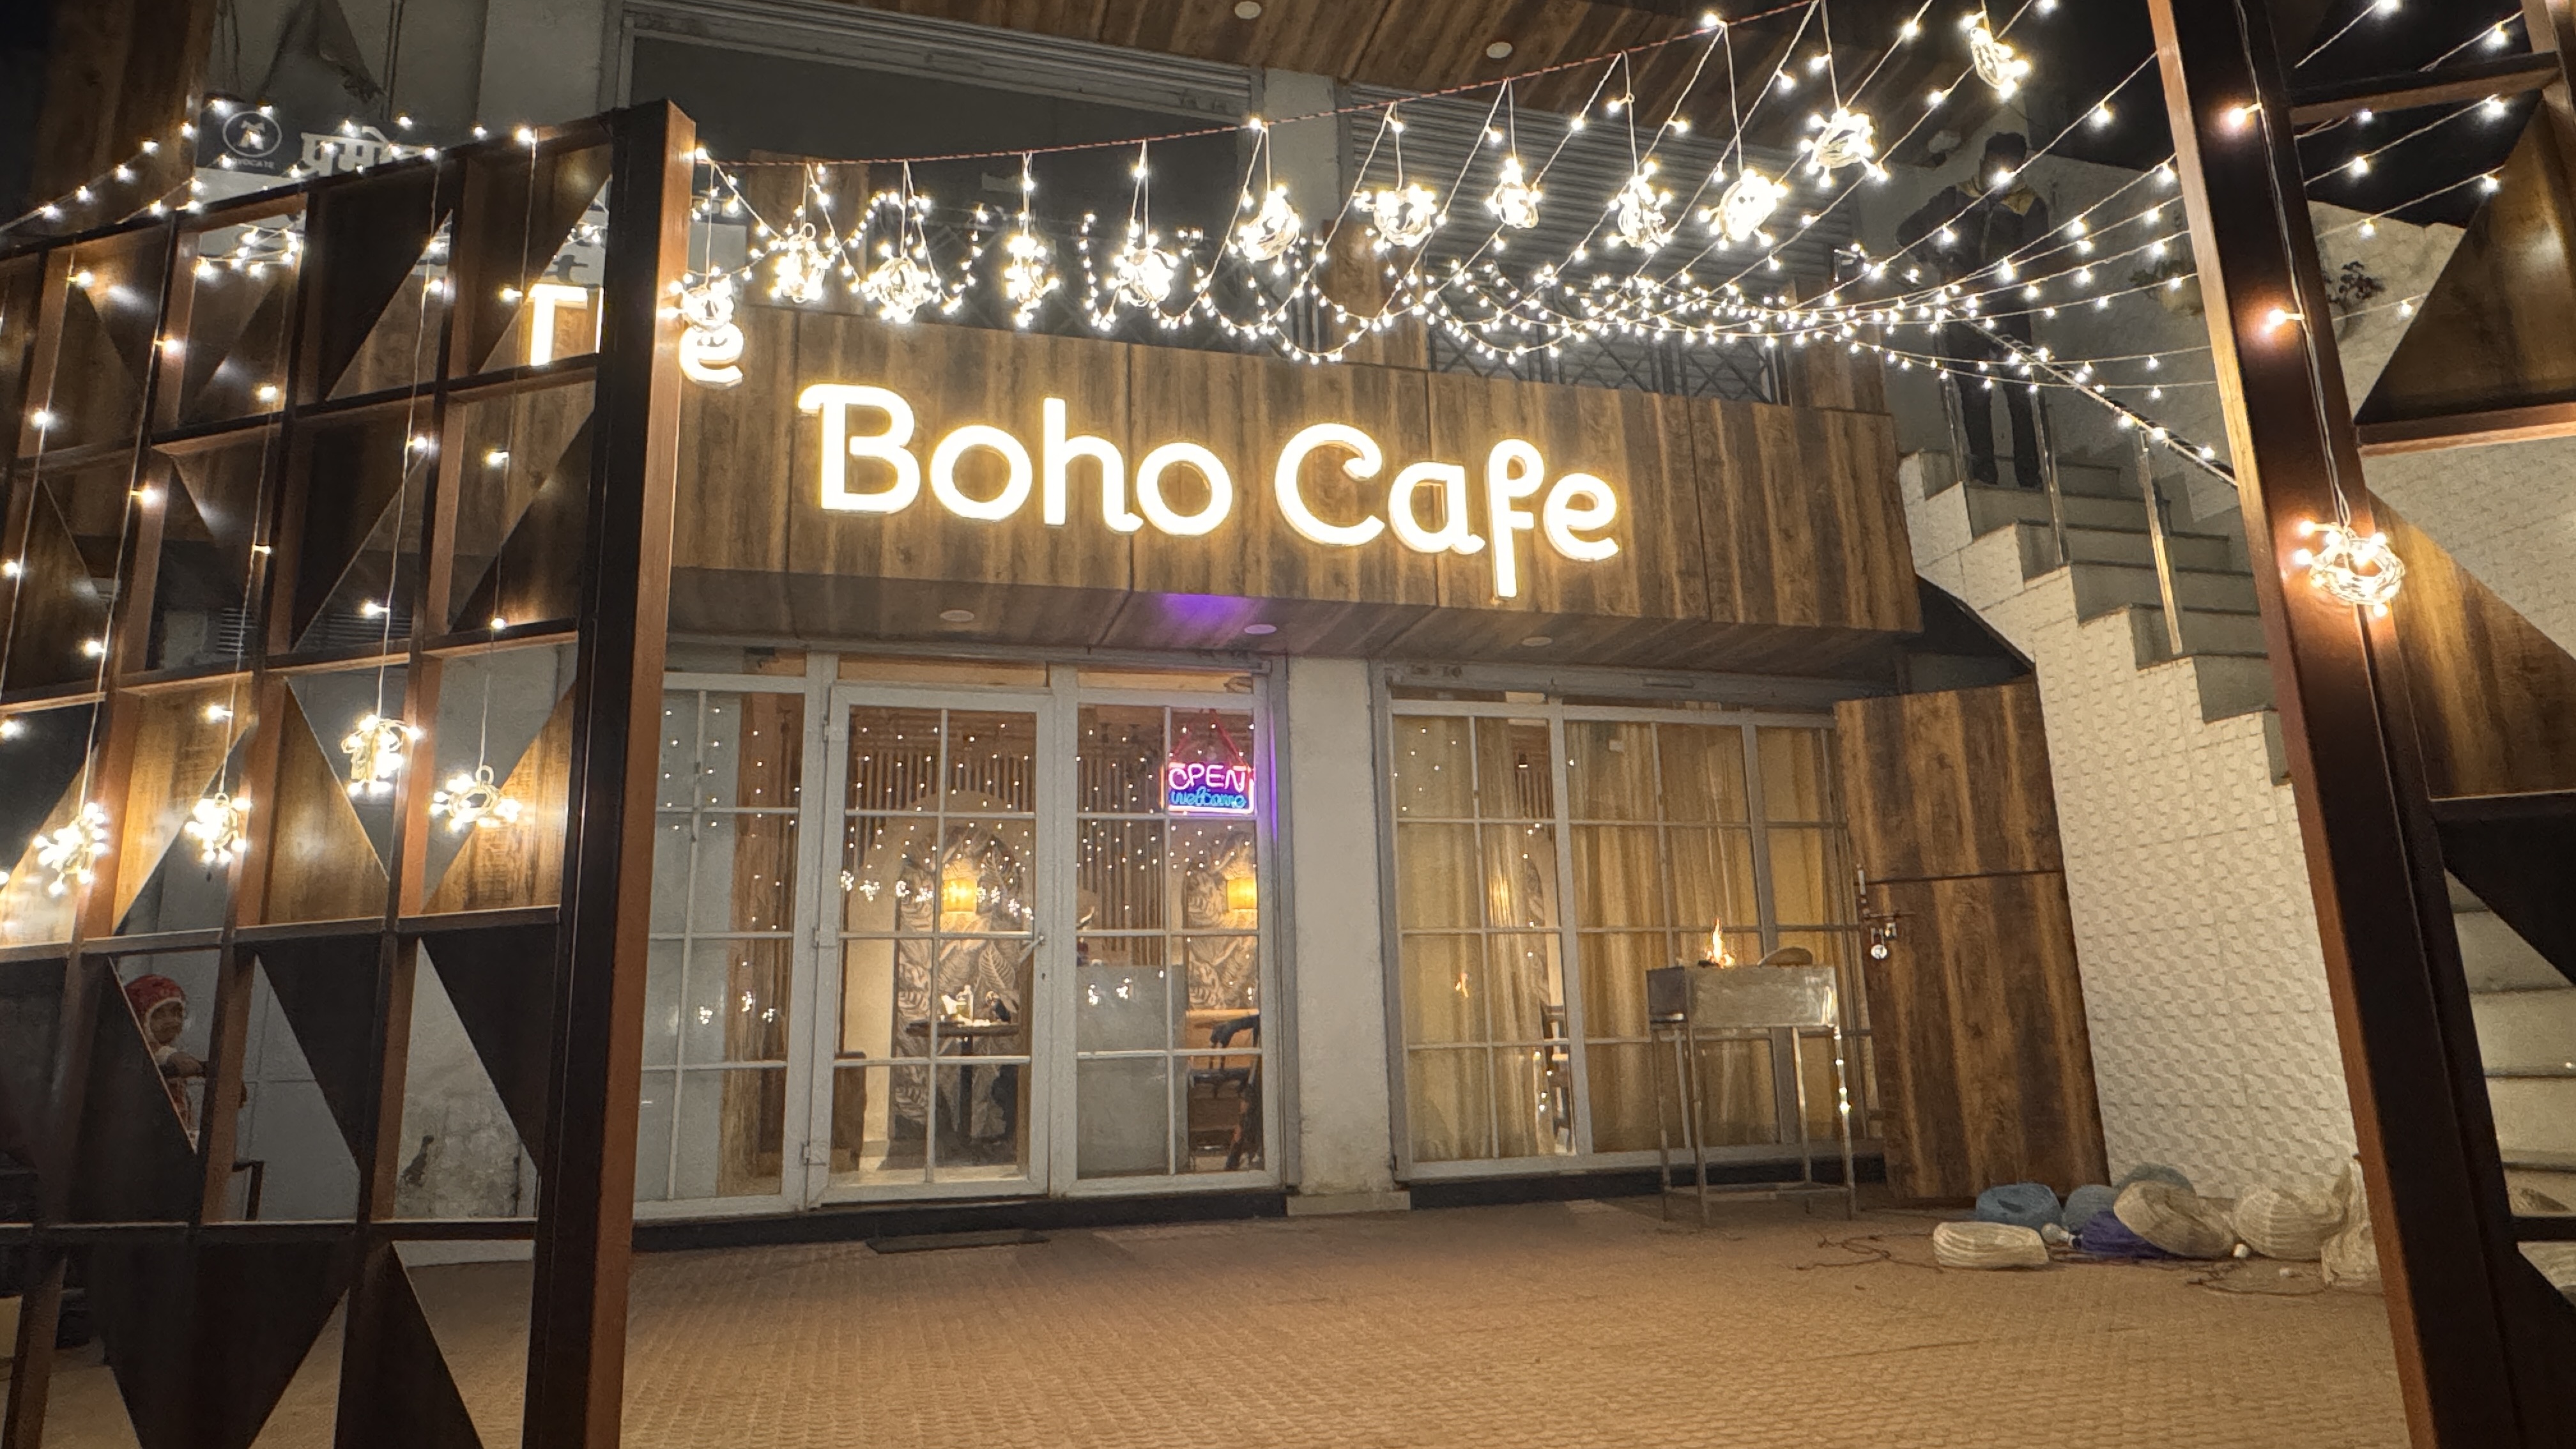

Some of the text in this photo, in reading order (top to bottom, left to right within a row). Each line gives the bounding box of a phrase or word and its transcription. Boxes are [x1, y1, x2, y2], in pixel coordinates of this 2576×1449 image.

[526, 283, 744, 386] Te
[797, 383, 1620, 599] Boho Cafe
[1169, 763, 1246, 793] OPEN
